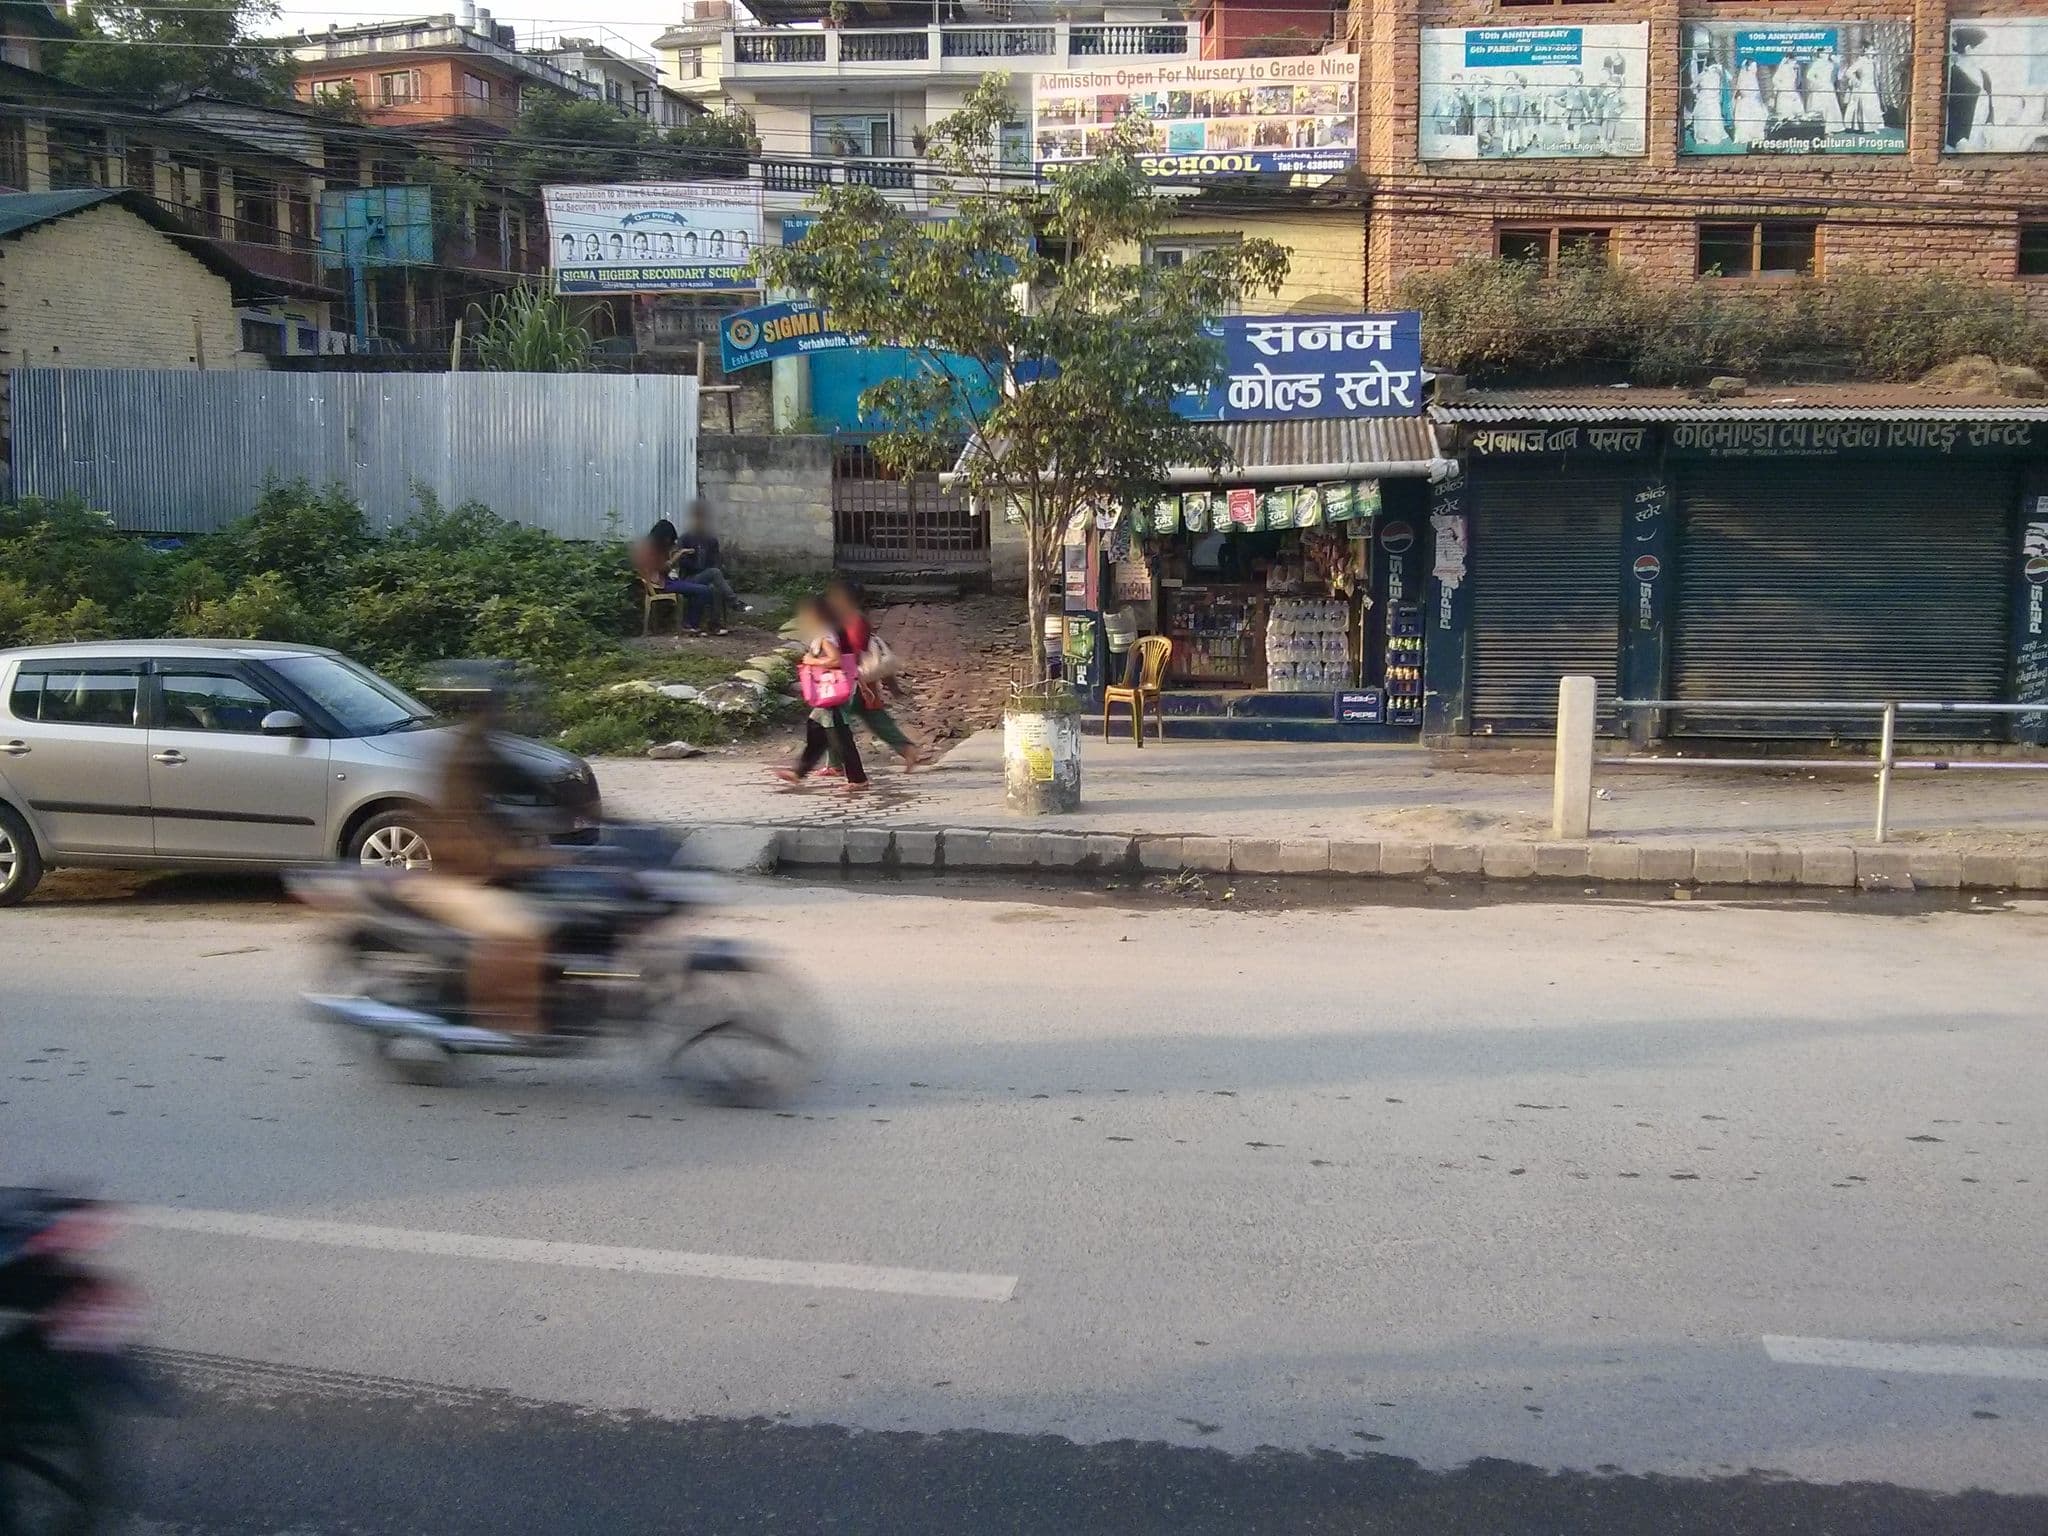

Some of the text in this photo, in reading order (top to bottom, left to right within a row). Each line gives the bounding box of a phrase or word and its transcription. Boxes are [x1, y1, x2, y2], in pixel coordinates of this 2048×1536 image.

[1039, 59, 1355, 91] Admission Open For Nursery to Grade Nine
[1751, 136, 1905, 150] Presenting Cultural Program
[1140, 154, 1261, 177] SCHOOL
[562, 270, 597, 281] SIGMA
[598, 269, 640, 281] HIGHER
[642, 268, 706, 280] SECONDARY
[763, 312, 820, 343] SIGMA
[1245, 320, 1397, 356] सनम
[1228, 359, 1417, 412] कोल्ड स्टोर
[1586, 427, 1647, 453] पसल
[1389, 555, 1402, 602] EPSI
[1440, 585, 1453, 630] PEPS
[1640, 582, 1653, 630] PEPSI
[2029, 584, 2043, 634] PEPSI
